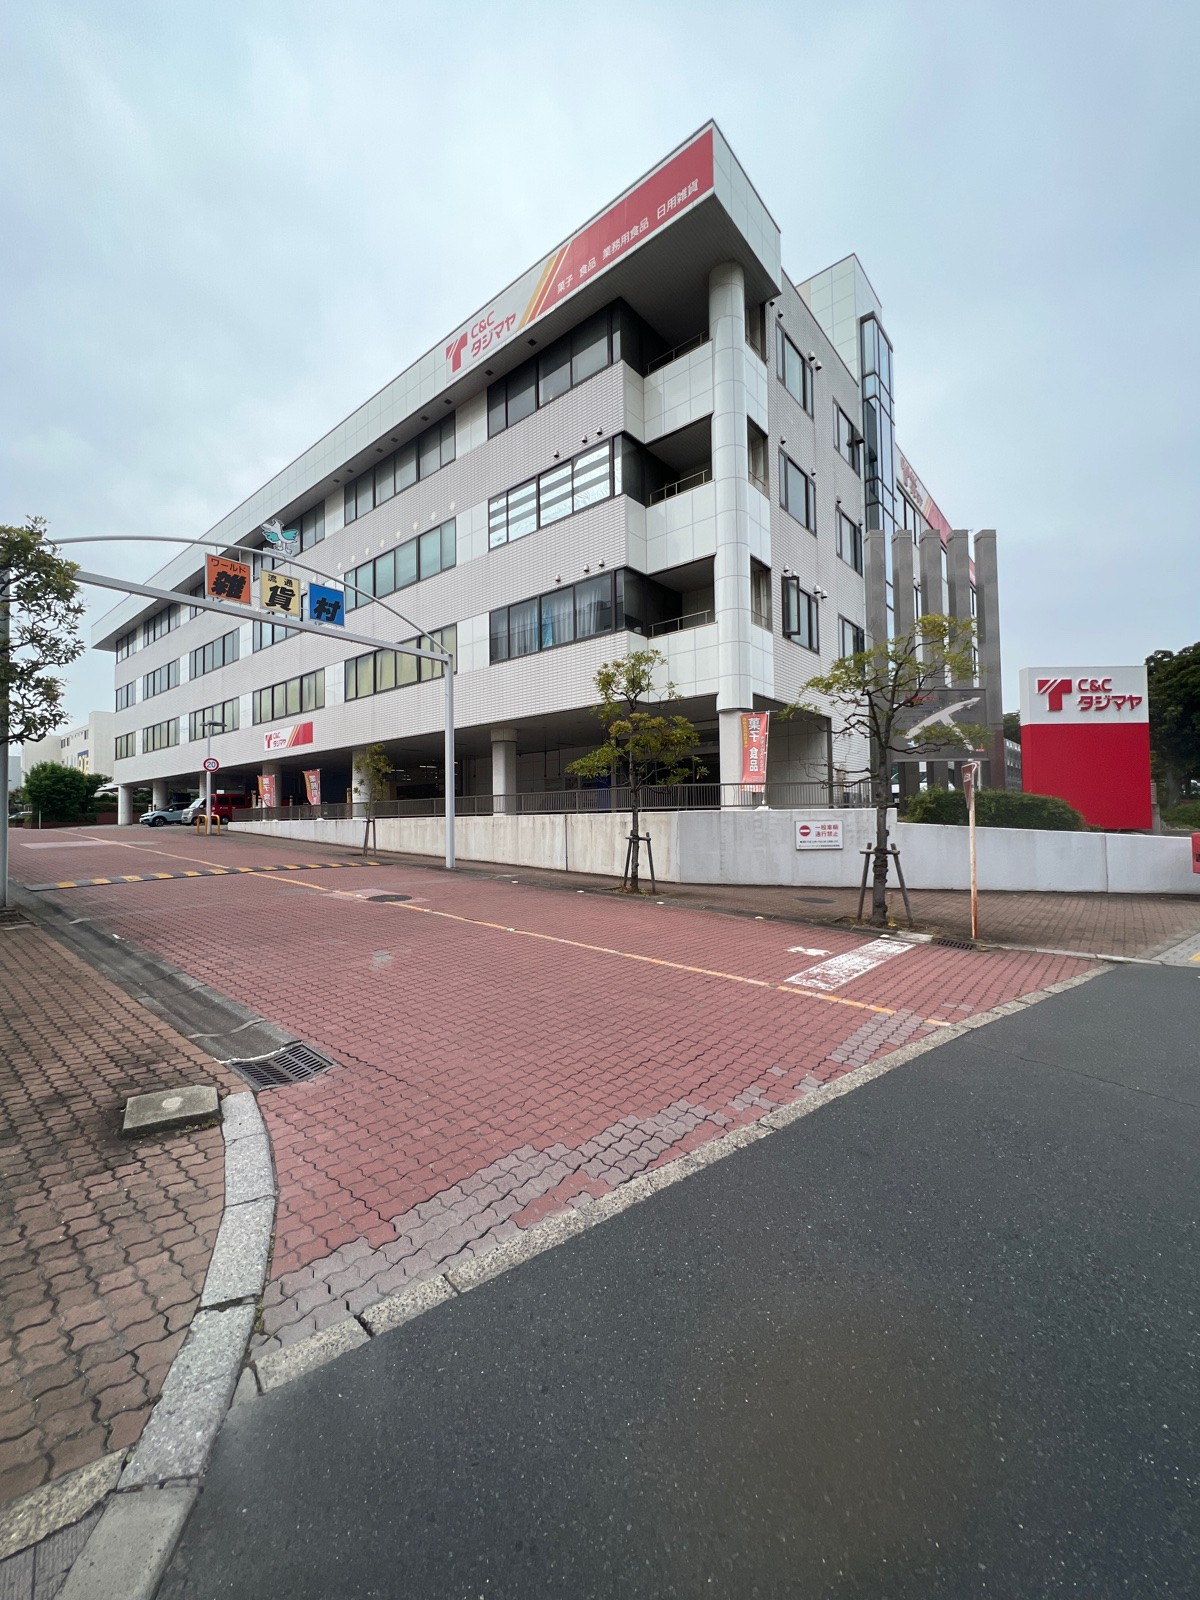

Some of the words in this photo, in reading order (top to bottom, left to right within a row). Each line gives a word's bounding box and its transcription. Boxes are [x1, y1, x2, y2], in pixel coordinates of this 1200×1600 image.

[556, 273, 574, 295] 菓子
[579, 256, 597, 279] 食品
[602, 216, 649, 261] 業務用食品
[656, 177, 699, 220] 日用雑貨
[470, 310, 495, 339] C&C
[471, 312, 517, 358] タジマヤ
[210, 558, 246, 574] ワールド
[211, 570, 247, 599] 雑
[267, 573, 293, 588] 流通
[265, 585, 296, 611] 貨
[313, 597, 341, 622] 村
[1077, 678, 1113, 693] C&C
[1078, 694, 1143, 712] タジマヤ
[748, 746, 759, 772] 食品
[815, 830, 839, 838] 通行禁止
